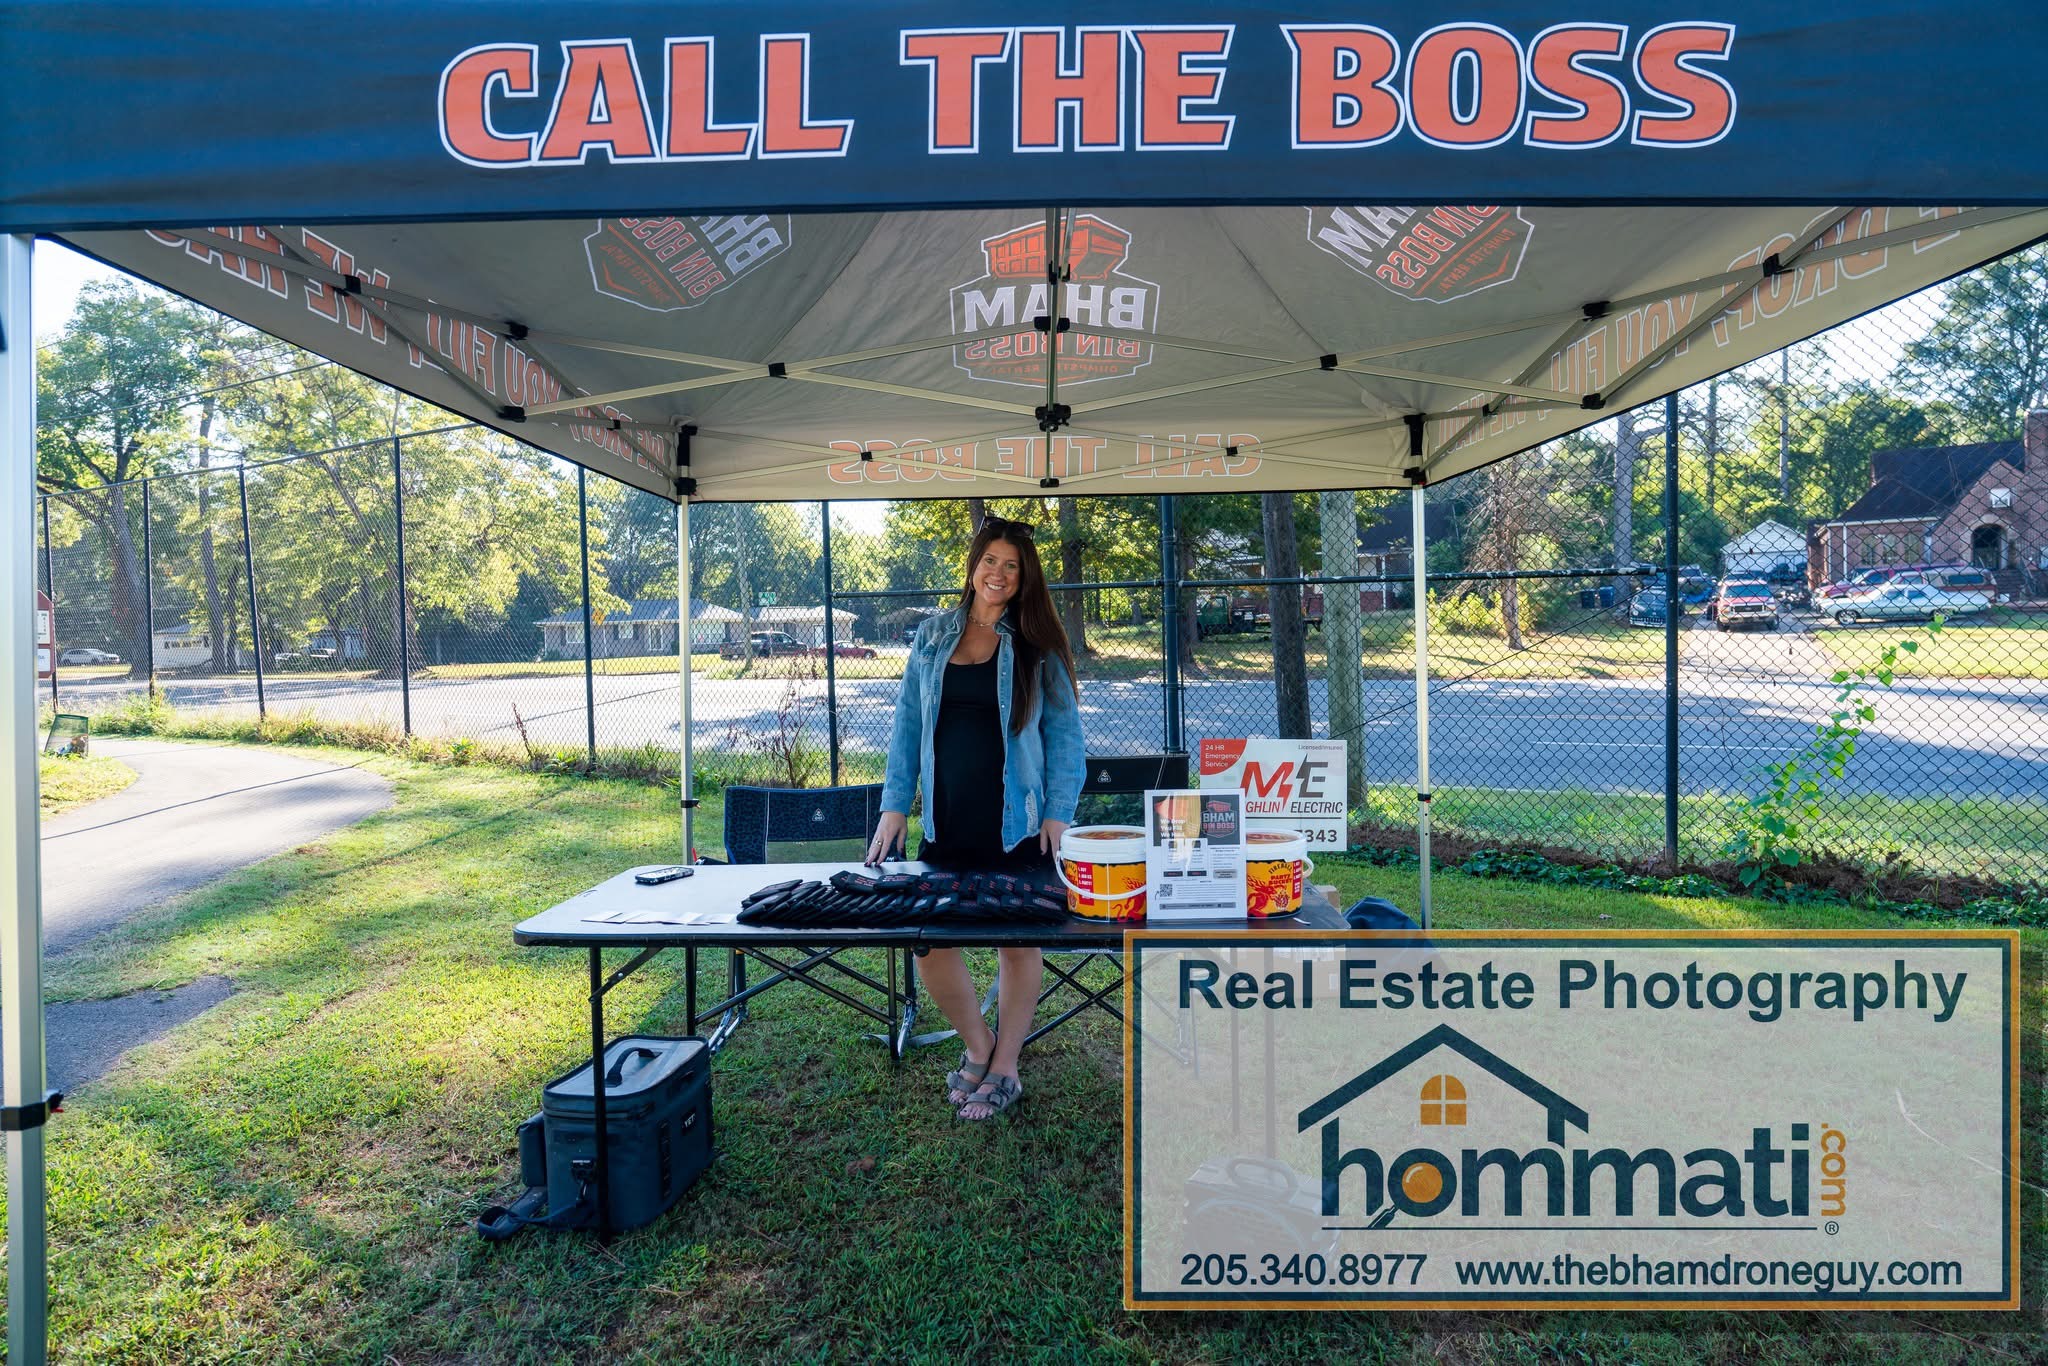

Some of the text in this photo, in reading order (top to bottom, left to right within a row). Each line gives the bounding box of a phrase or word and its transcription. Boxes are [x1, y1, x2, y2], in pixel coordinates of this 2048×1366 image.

[438, 20, 1738, 169] CALL THE BOSS
[1290, 801, 1344, 814] ELECTRIC
[1203, 812, 1235, 822] BHAM
[1294, 829, 1338, 843] 343
